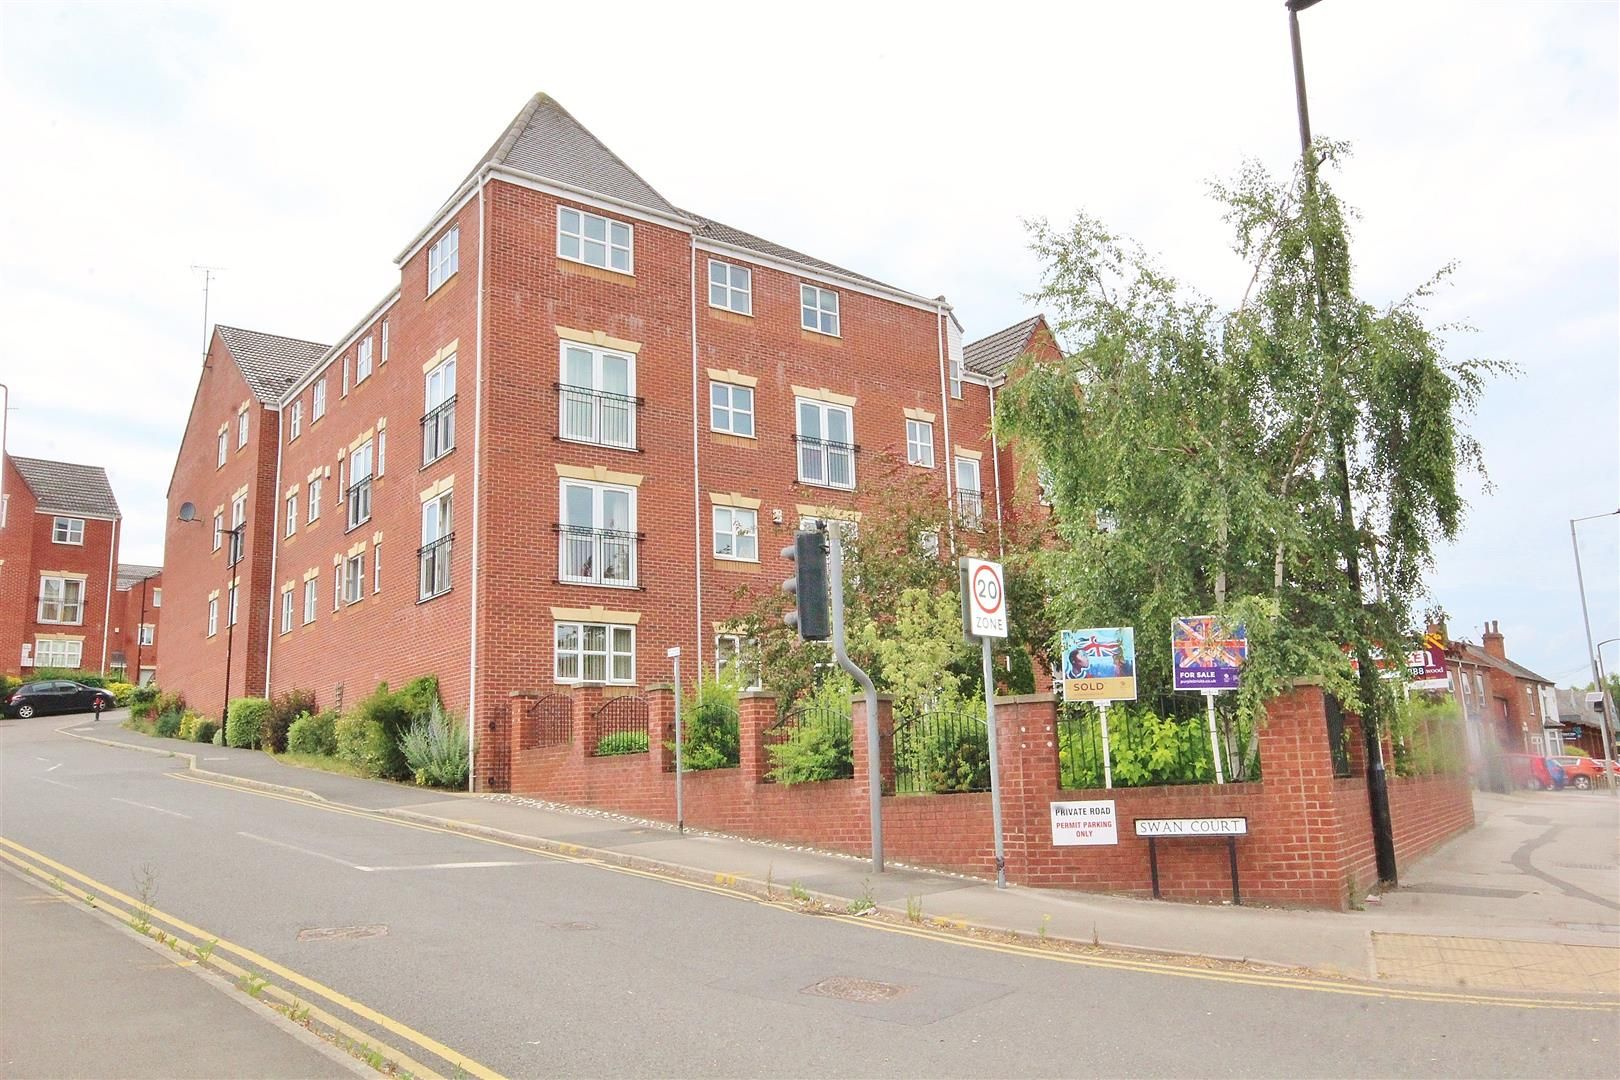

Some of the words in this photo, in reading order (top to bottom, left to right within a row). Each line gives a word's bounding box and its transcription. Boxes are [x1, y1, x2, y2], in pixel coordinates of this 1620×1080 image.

[977, 579, 997, 599] 20
[976, 616, 1003, 631] ZONE
[1073, 682, 1104, 692] SOLD
[1055, 807, 1087, 816] PRIVATE
[1089, 807, 1111, 815] ROAD
[1056, 821, 1081, 829] PERMIT
[1083, 820, 1112, 829] PARKING
[1140, 821, 1183, 833] SWAN
[1190, 820, 1240, 832] COURT
[1076, 830, 1093, 838] ONLY
